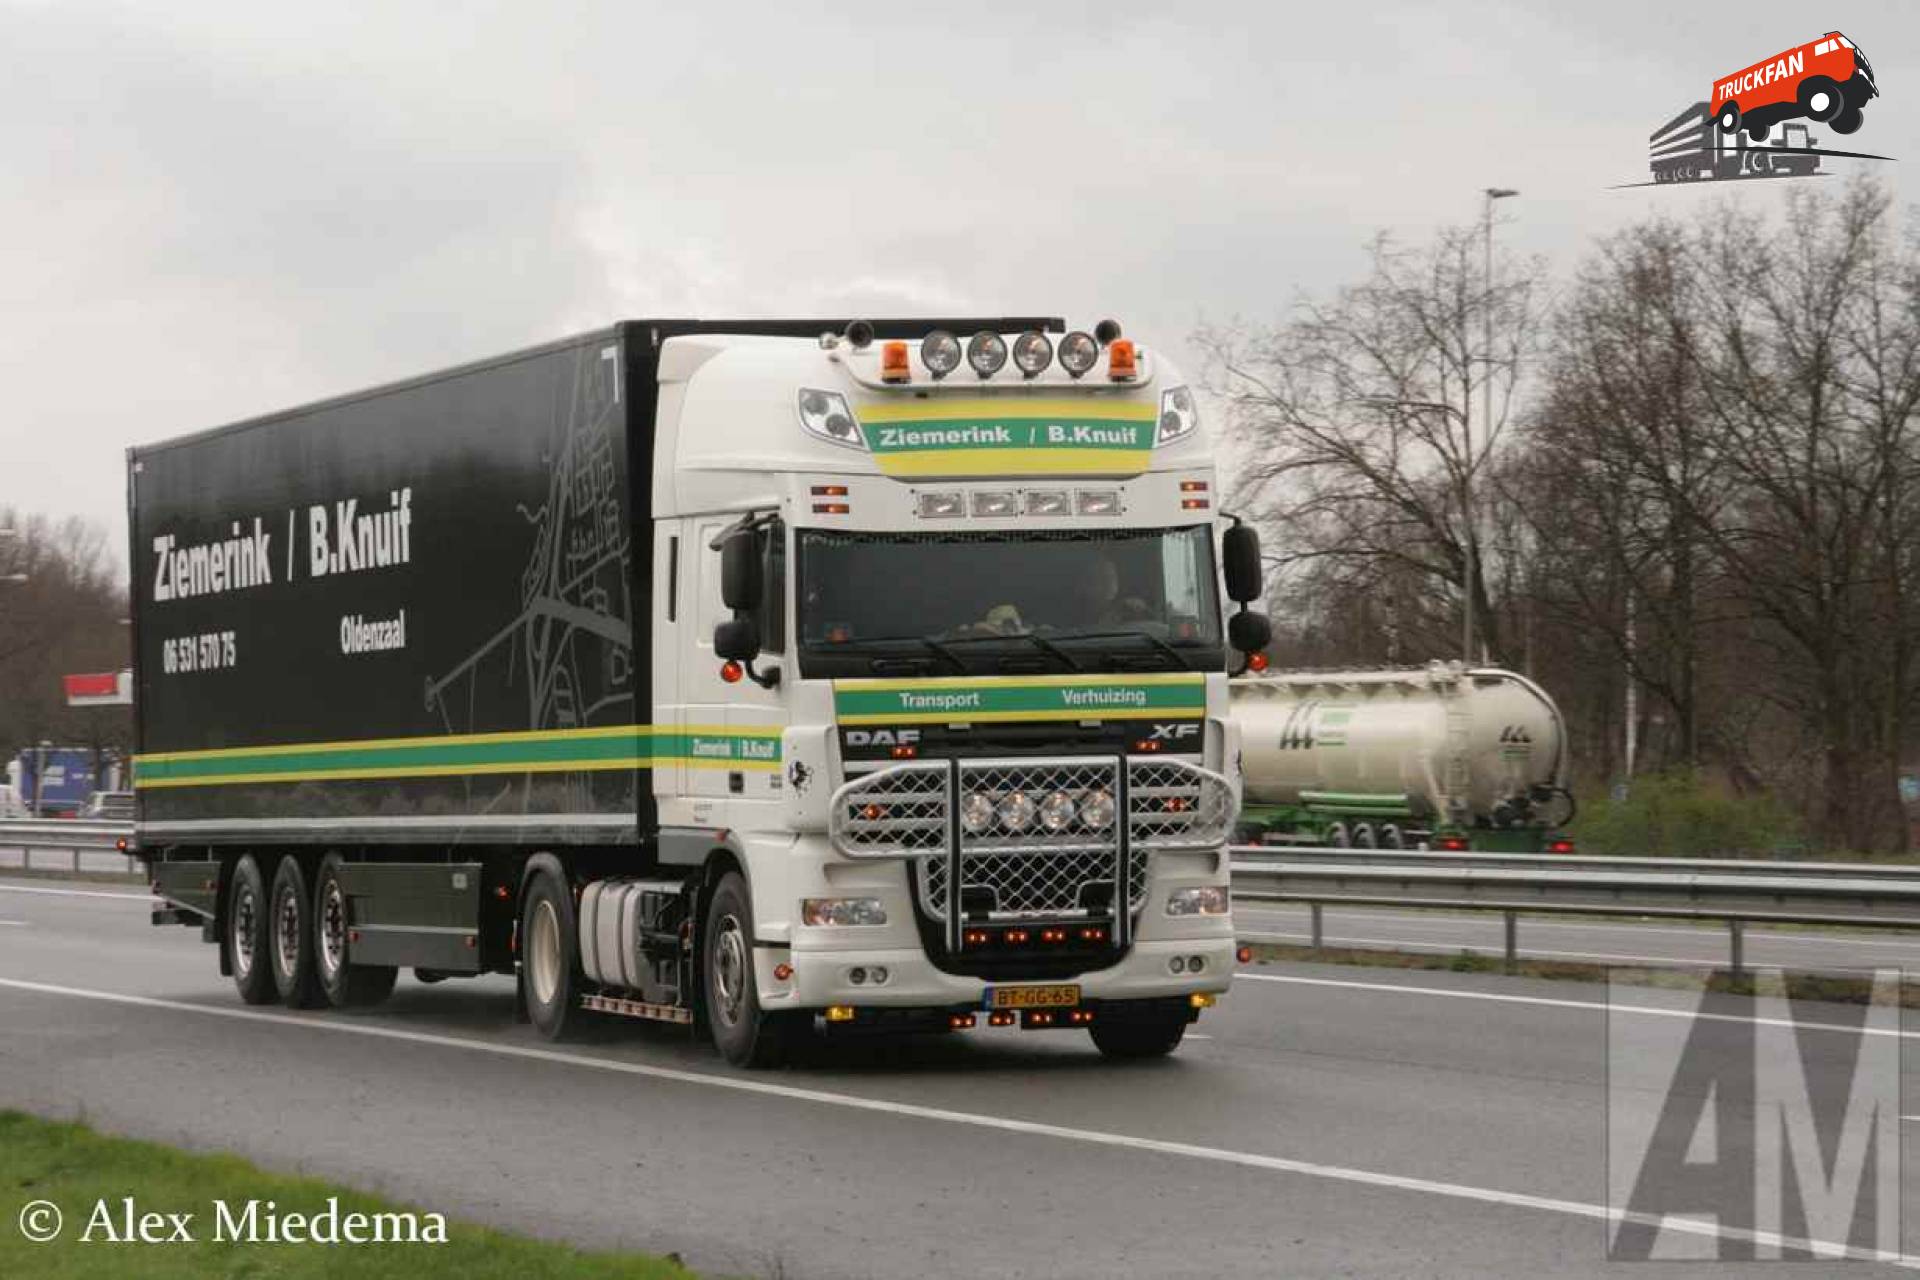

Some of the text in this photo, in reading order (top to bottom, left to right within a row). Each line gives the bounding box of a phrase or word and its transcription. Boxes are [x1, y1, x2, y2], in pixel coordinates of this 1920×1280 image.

[879, 426, 1011, 447] Ziemerink
[1048, 425, 1138, 444] B.Knuif
[153, 516, 272, 601] Ziemerink
[308, 487, 412, 577] B.Knuif
[340, 609, 405, 654] Oldenzaal
[221, 631, 236, 667] 75
[899, 692, 981, 710] Transport
[1062, 688, 1147, 706] Verhuizing
[846, 730, 920, 746] DAF
[1150, 724, 1200, 739] XF
[999, 987, 1075, 1006] BT-GG-65
